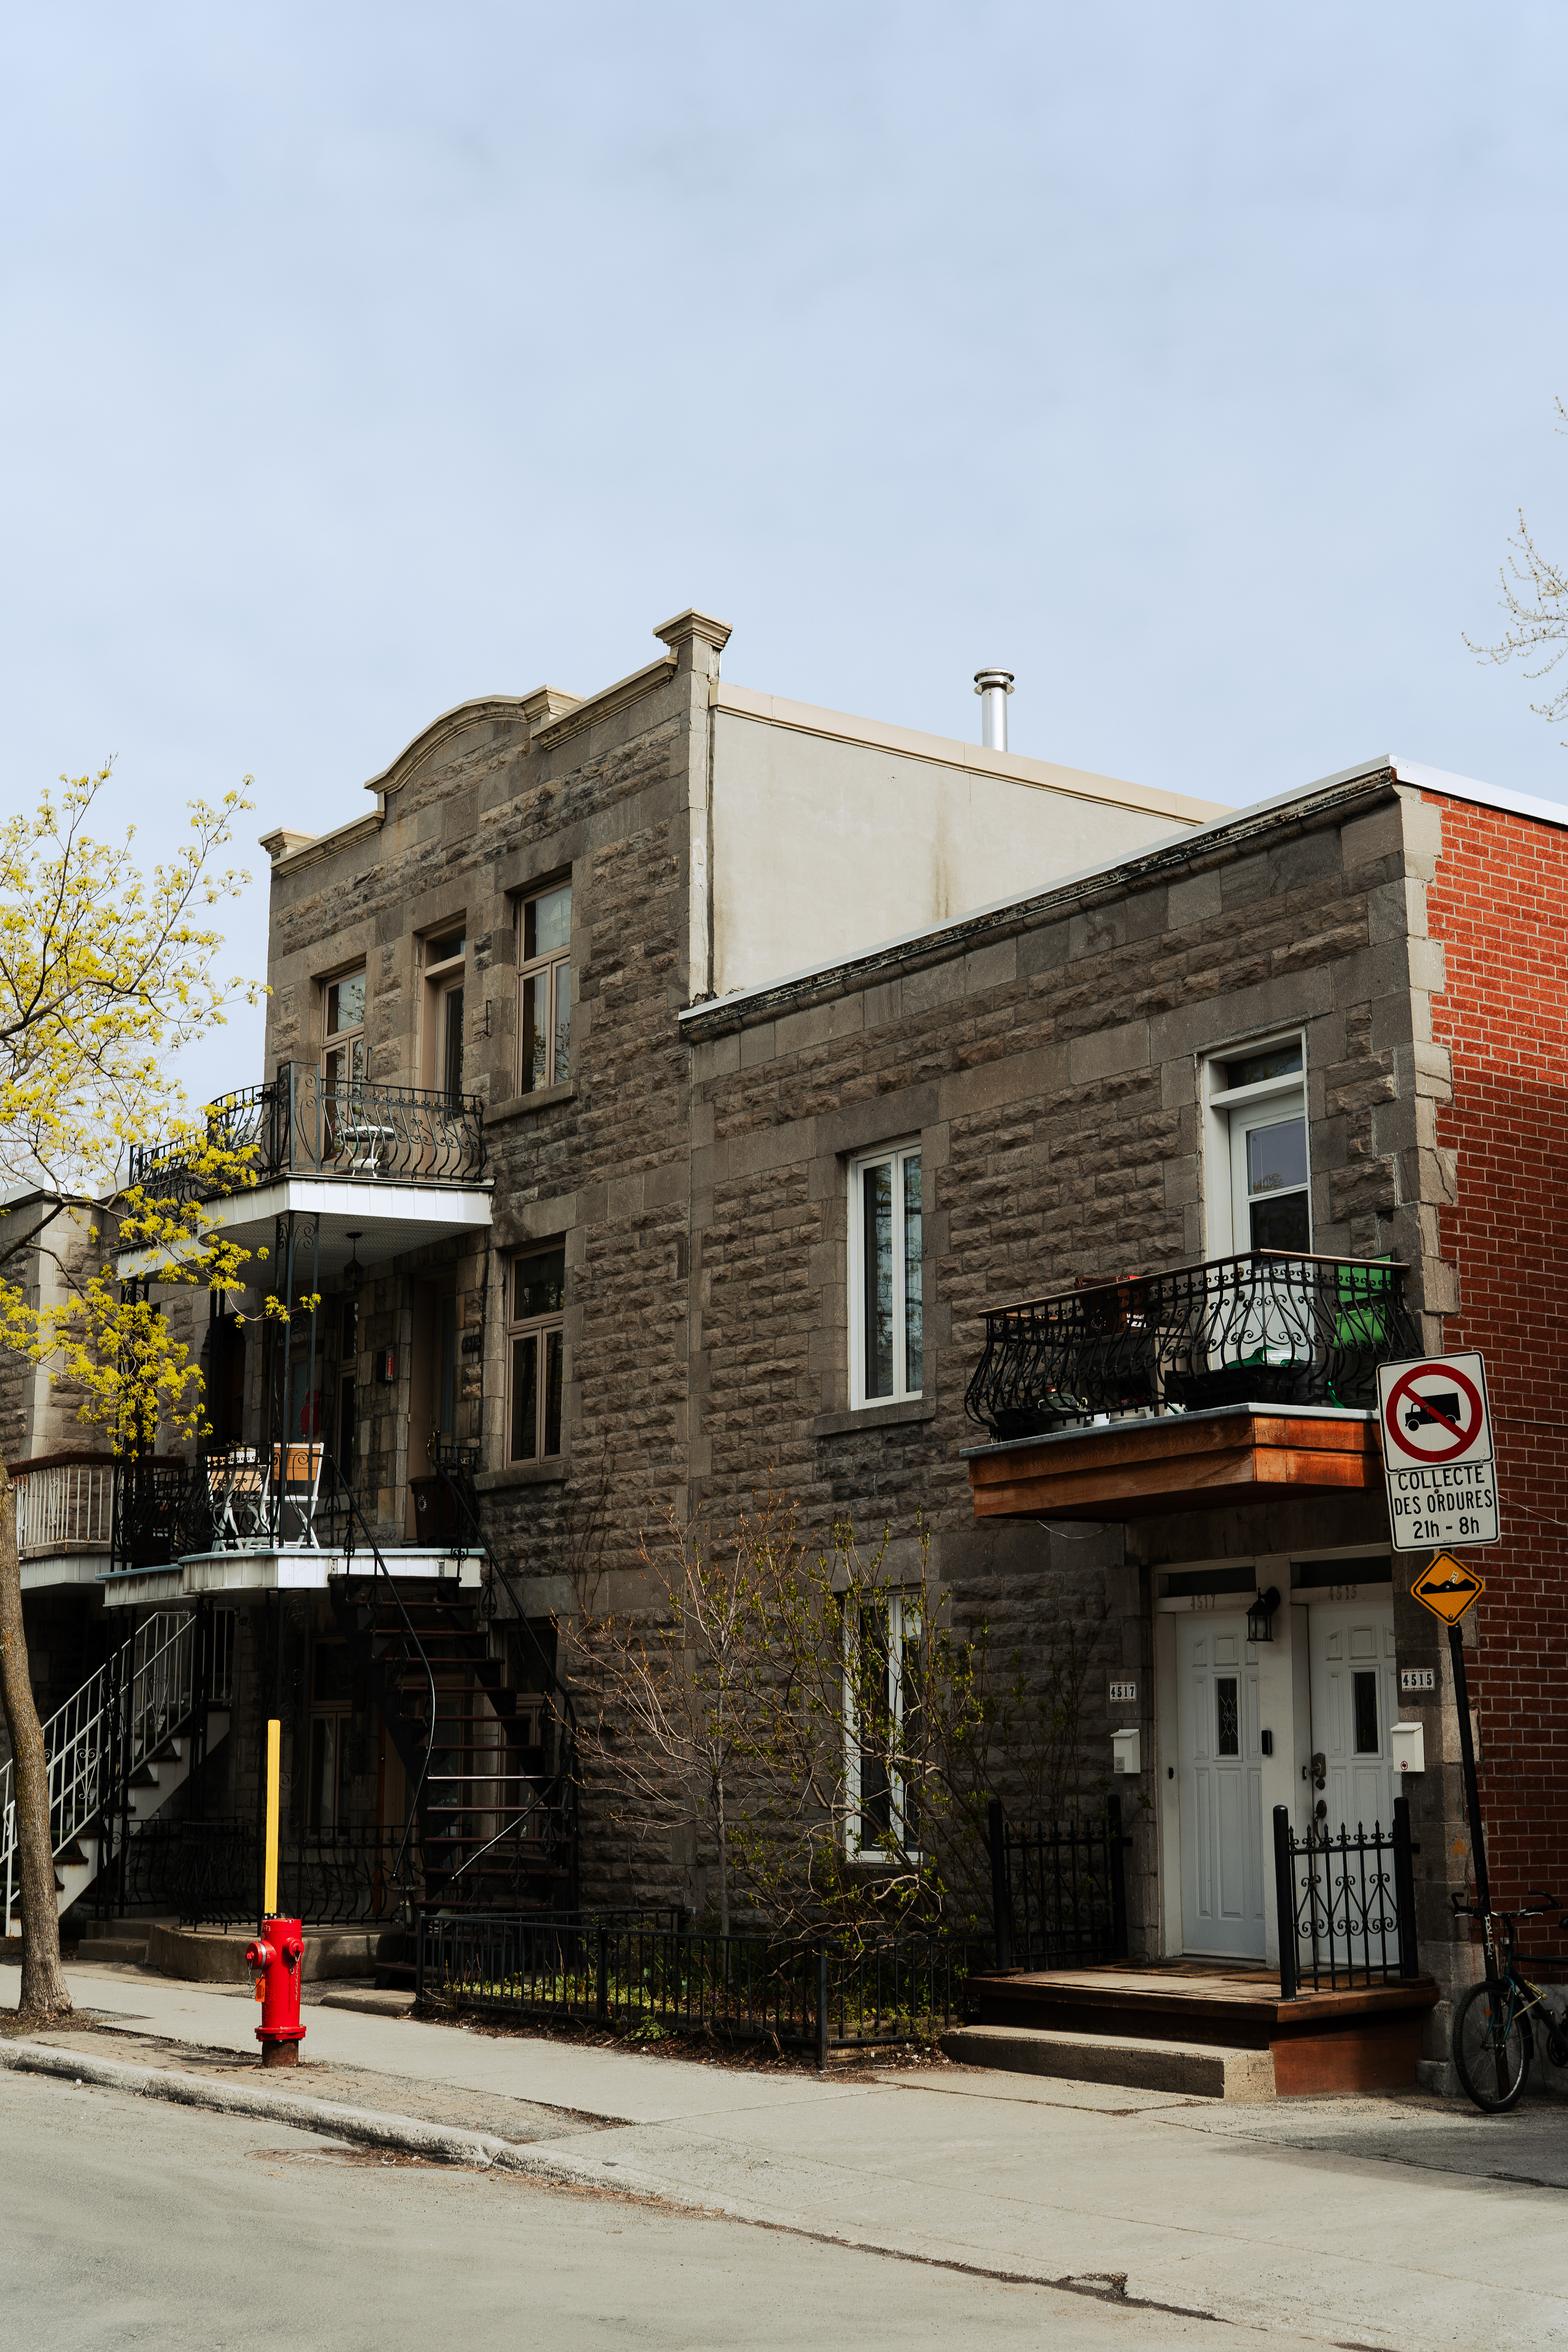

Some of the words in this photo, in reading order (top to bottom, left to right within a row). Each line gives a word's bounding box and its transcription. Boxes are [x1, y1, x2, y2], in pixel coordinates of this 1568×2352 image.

[1398, 1465, 1485, 1491] COLLECTE
[1394, 1496, 1421, 1516] DES
[1427, 1489, 1493, 1513] ORDURES
[1412, 1520, 1440, 1539] 21h
[1459, 1516, 1480, 1535] 8h
[1329, 1585, 1357, 1601] 4515
[1191, 1594, 1216, 1610] 4517
[1403, 1673, 1432, 1686] 4515
[1111, 1686, 1135, 1698] 4517
